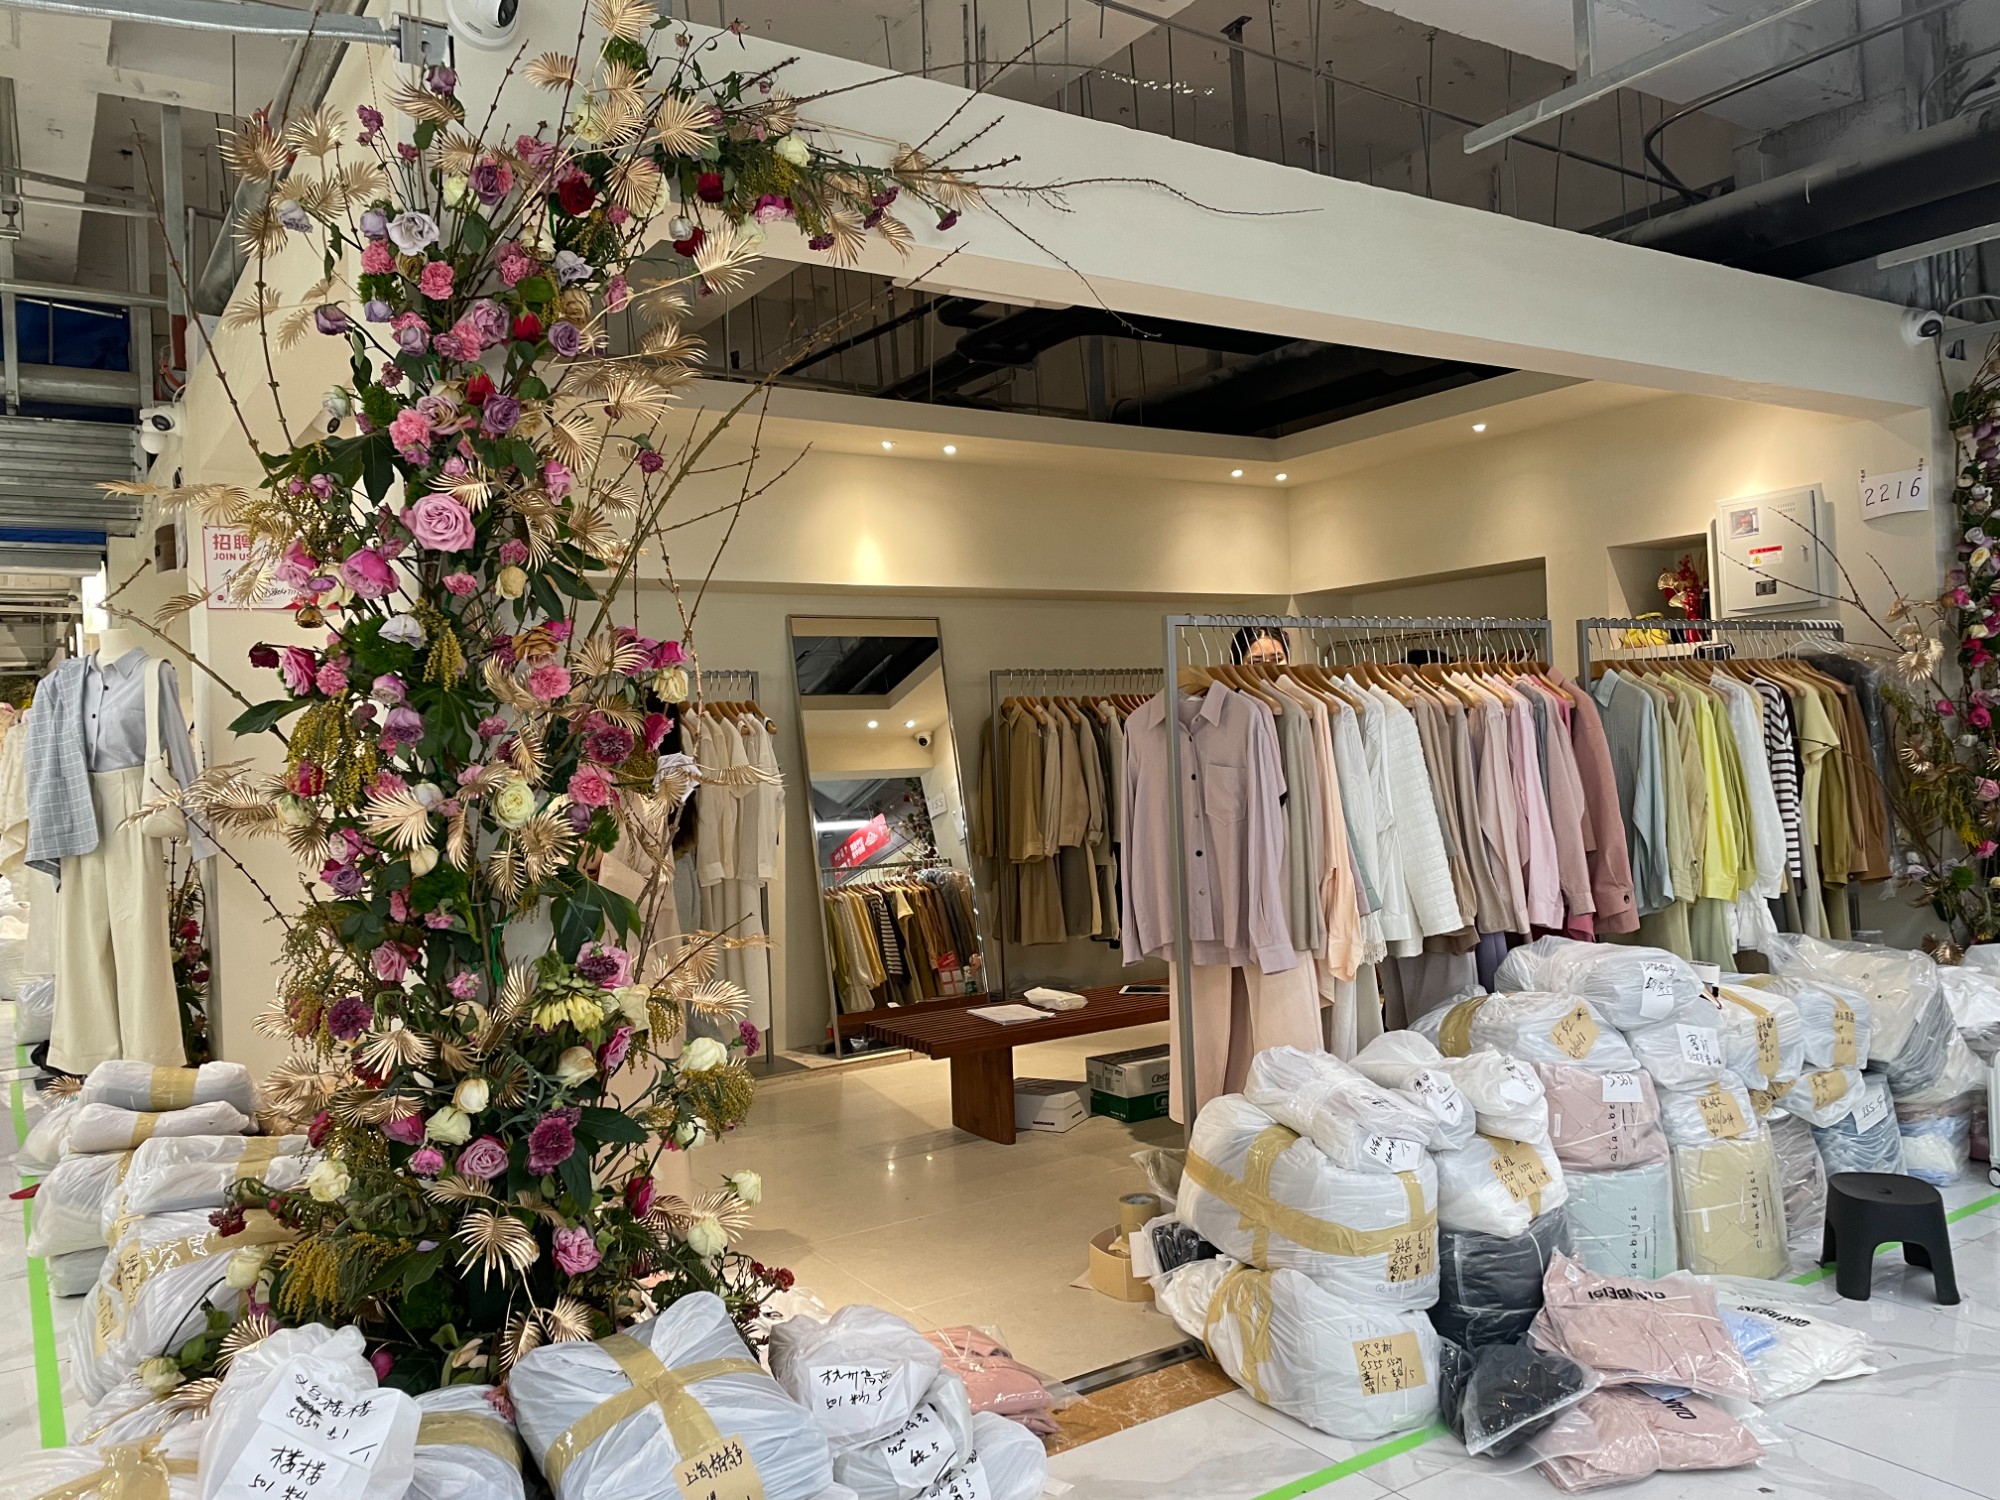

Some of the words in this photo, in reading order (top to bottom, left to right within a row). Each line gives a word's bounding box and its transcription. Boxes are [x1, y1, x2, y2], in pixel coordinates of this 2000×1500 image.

[1864, 477, 1922, 507] 2216
[212, 533, 251, 551] 招聘
[213, 552, 236, 561] JOIN
